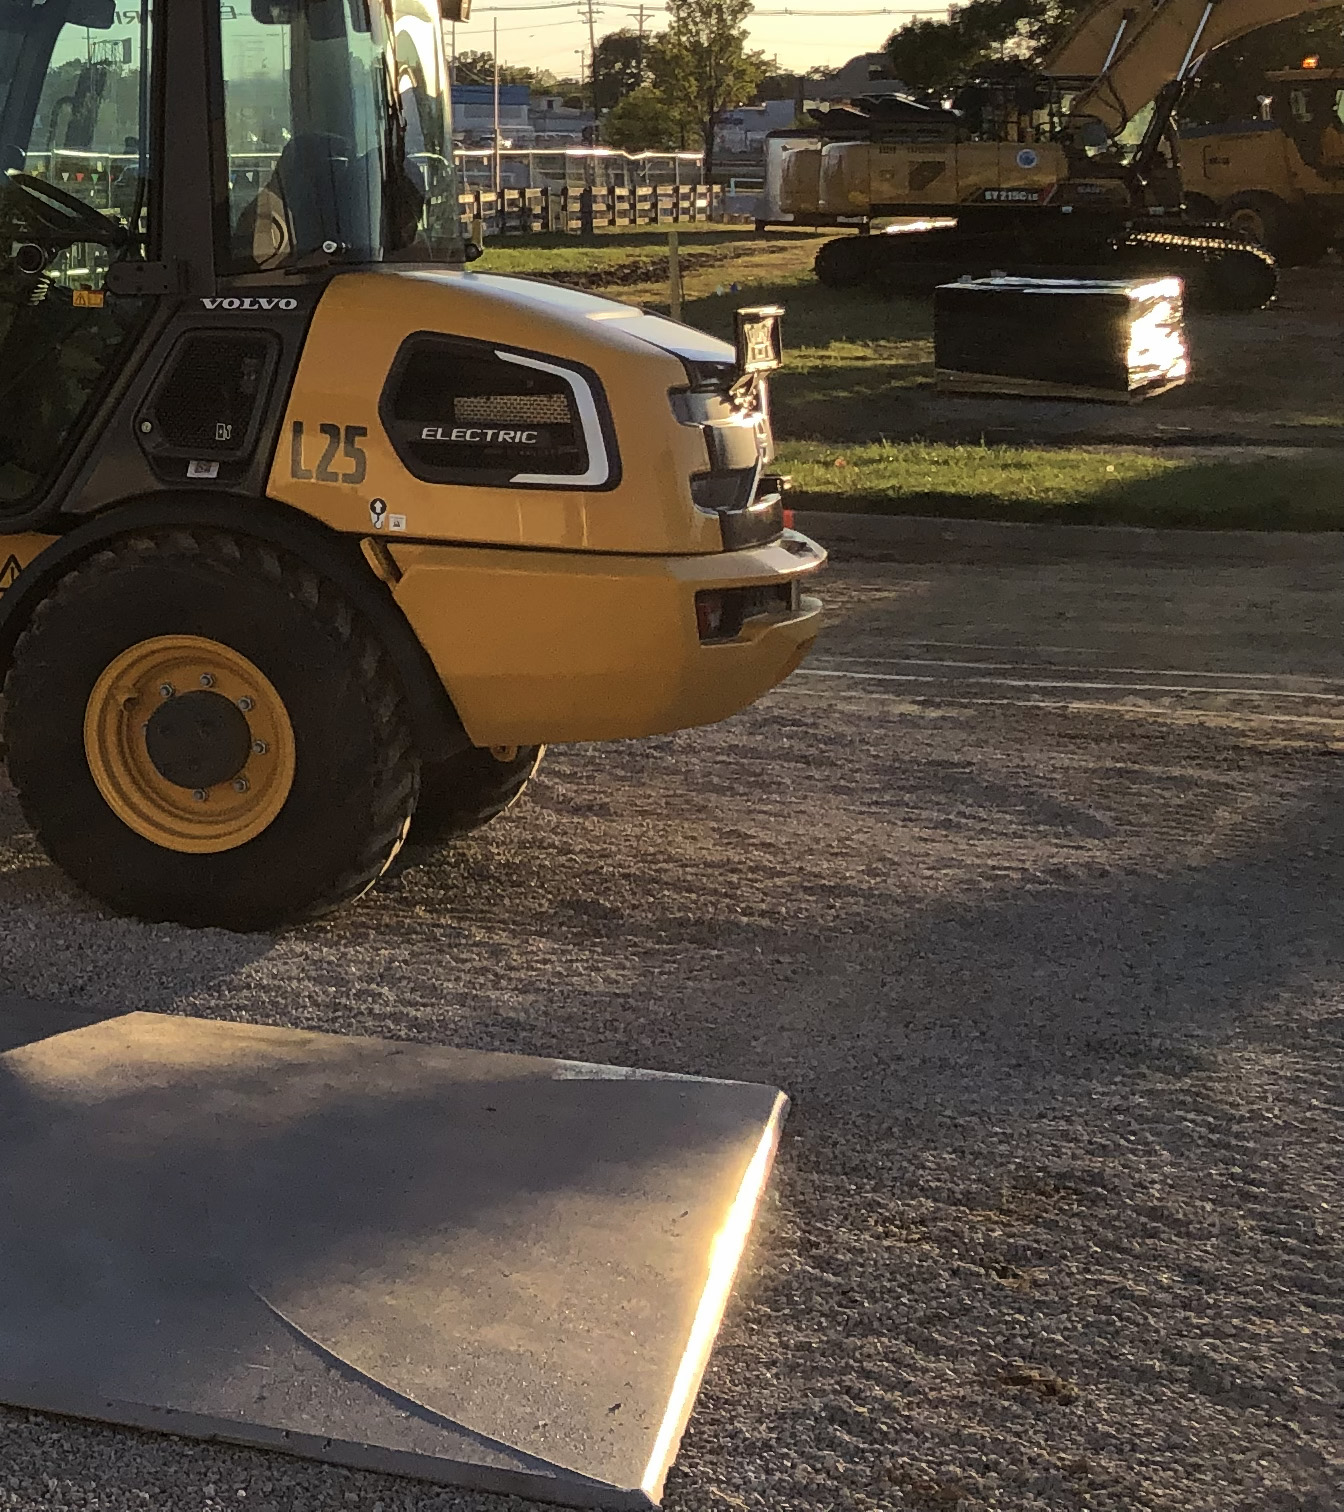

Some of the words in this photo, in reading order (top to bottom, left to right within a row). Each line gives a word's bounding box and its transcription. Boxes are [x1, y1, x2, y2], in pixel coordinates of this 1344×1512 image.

[199, 297, 298, 311] VOLVO
[420, 426, 538, 445] ELECTRIC
[290, 420, 368, 485] L25
